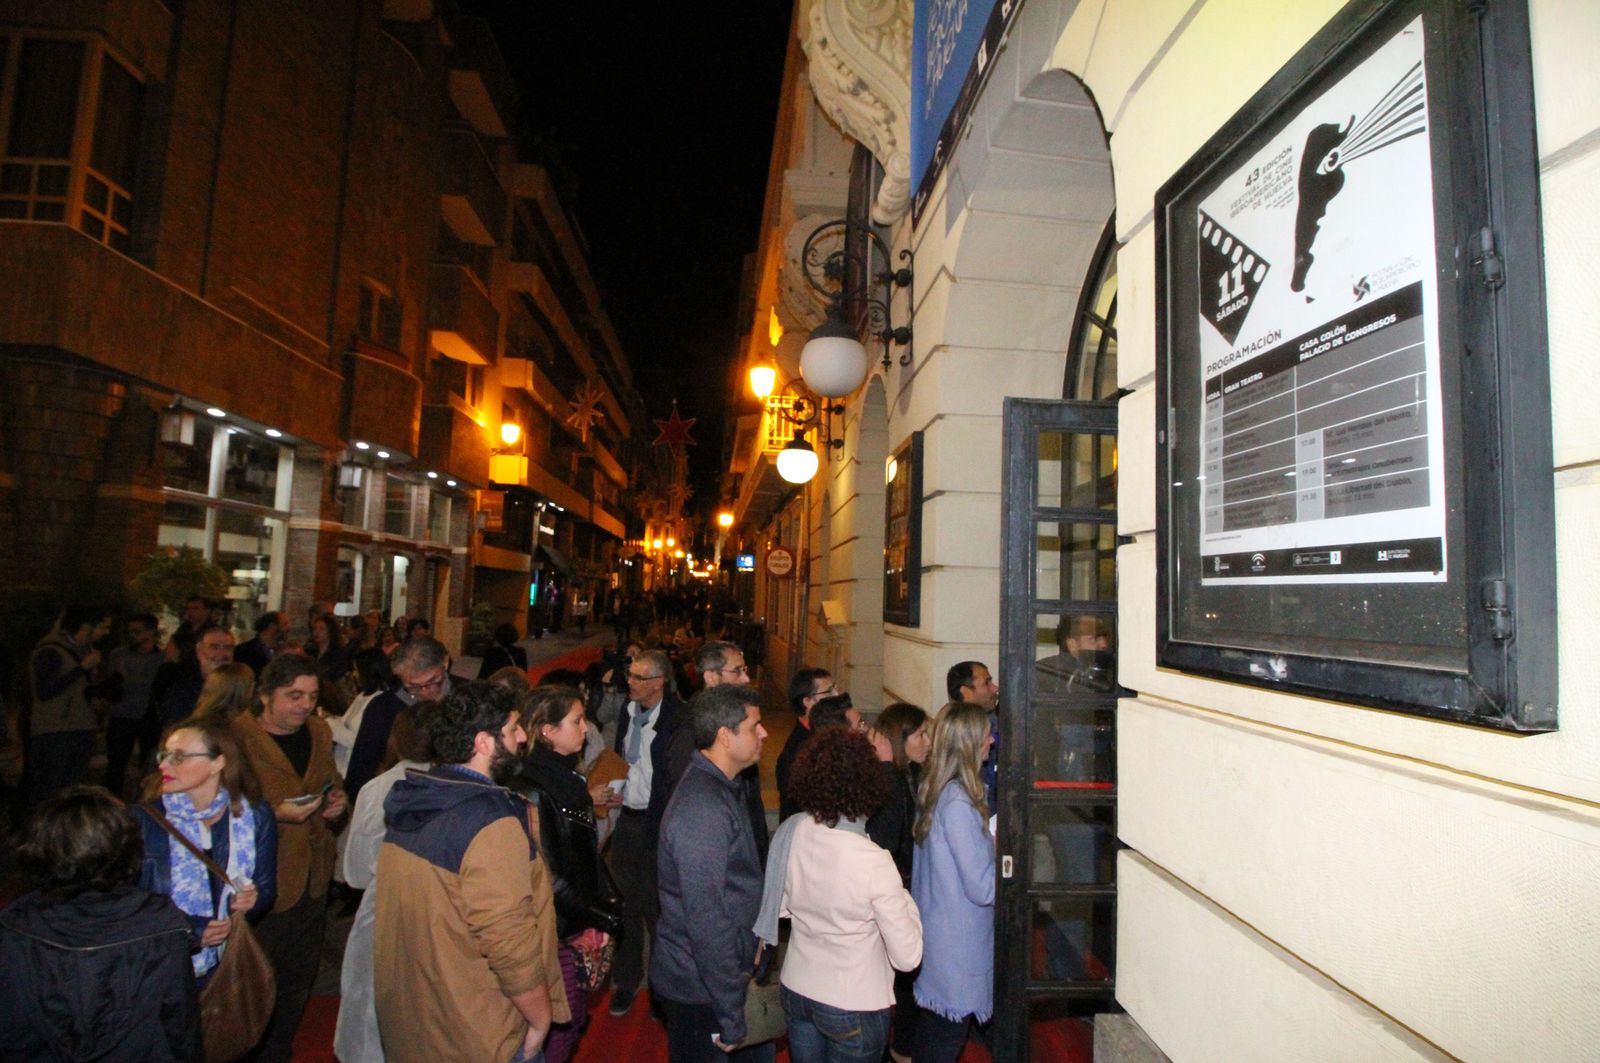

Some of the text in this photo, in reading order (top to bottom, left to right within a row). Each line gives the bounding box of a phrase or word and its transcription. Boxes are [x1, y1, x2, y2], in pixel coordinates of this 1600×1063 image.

[1244, 167, 1260, 188] 43
[1218, 260, 1246, 308] 11
[1216, 295, 1249, 322] SÁBADO
[1206, 328, 1283, 376] PROGRAMACIÓN
[1299, 323, 1347, 352] CASA COLÓN
[1299, 313, 1398, 362] PALACIO DE CONGRESOS
[1224, 380, 1240, 394] GRAN
[1240, 371, 1265, 387] TEATRO
